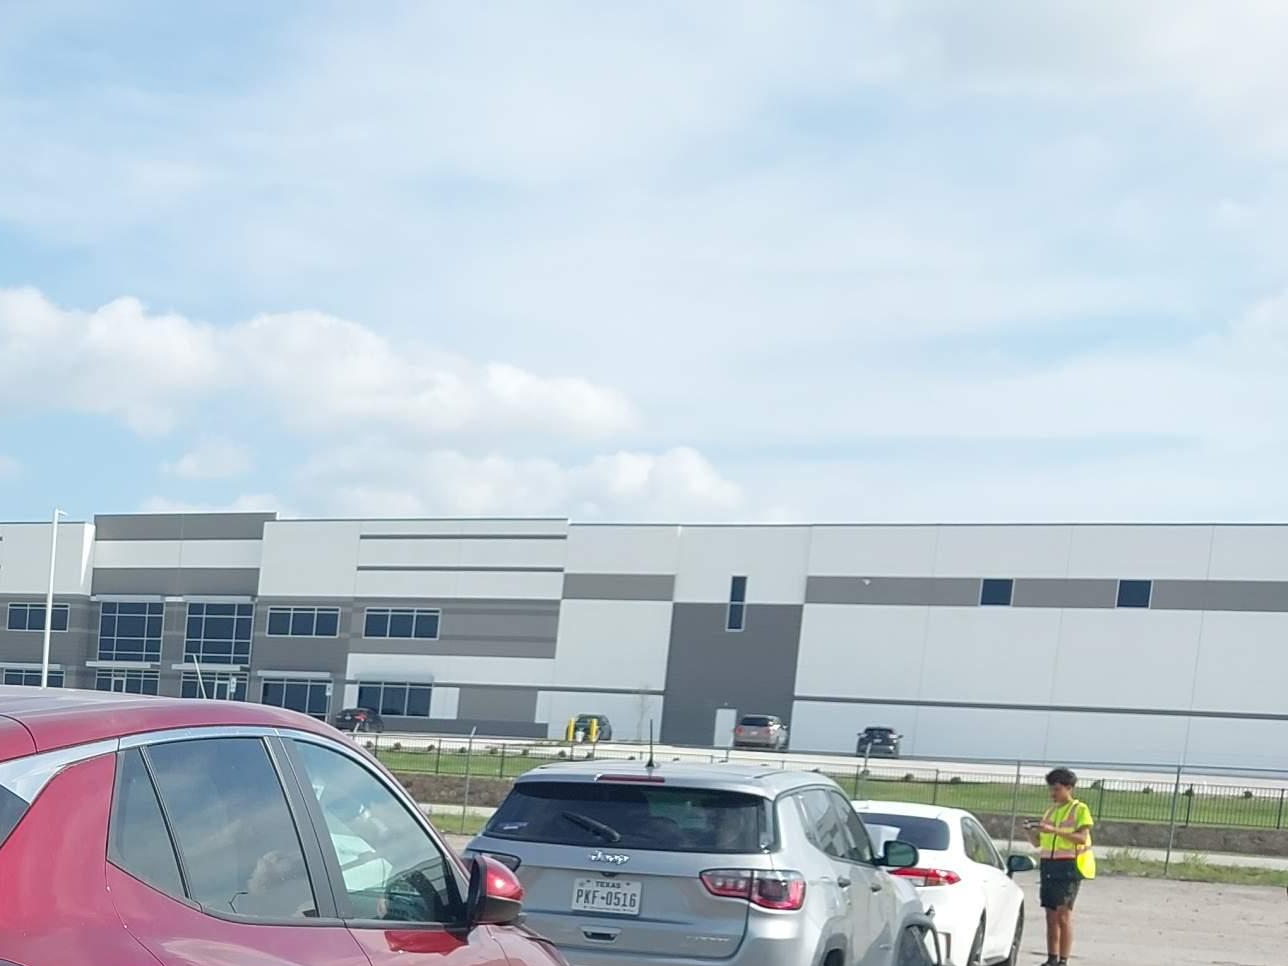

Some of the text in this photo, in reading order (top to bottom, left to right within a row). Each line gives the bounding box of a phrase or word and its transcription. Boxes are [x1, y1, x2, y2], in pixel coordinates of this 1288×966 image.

[590, 850, 630, 865] Jeep
[596, 881, 621, 889] TEXAS
[576, 888, 637, 908] PKF-0516
